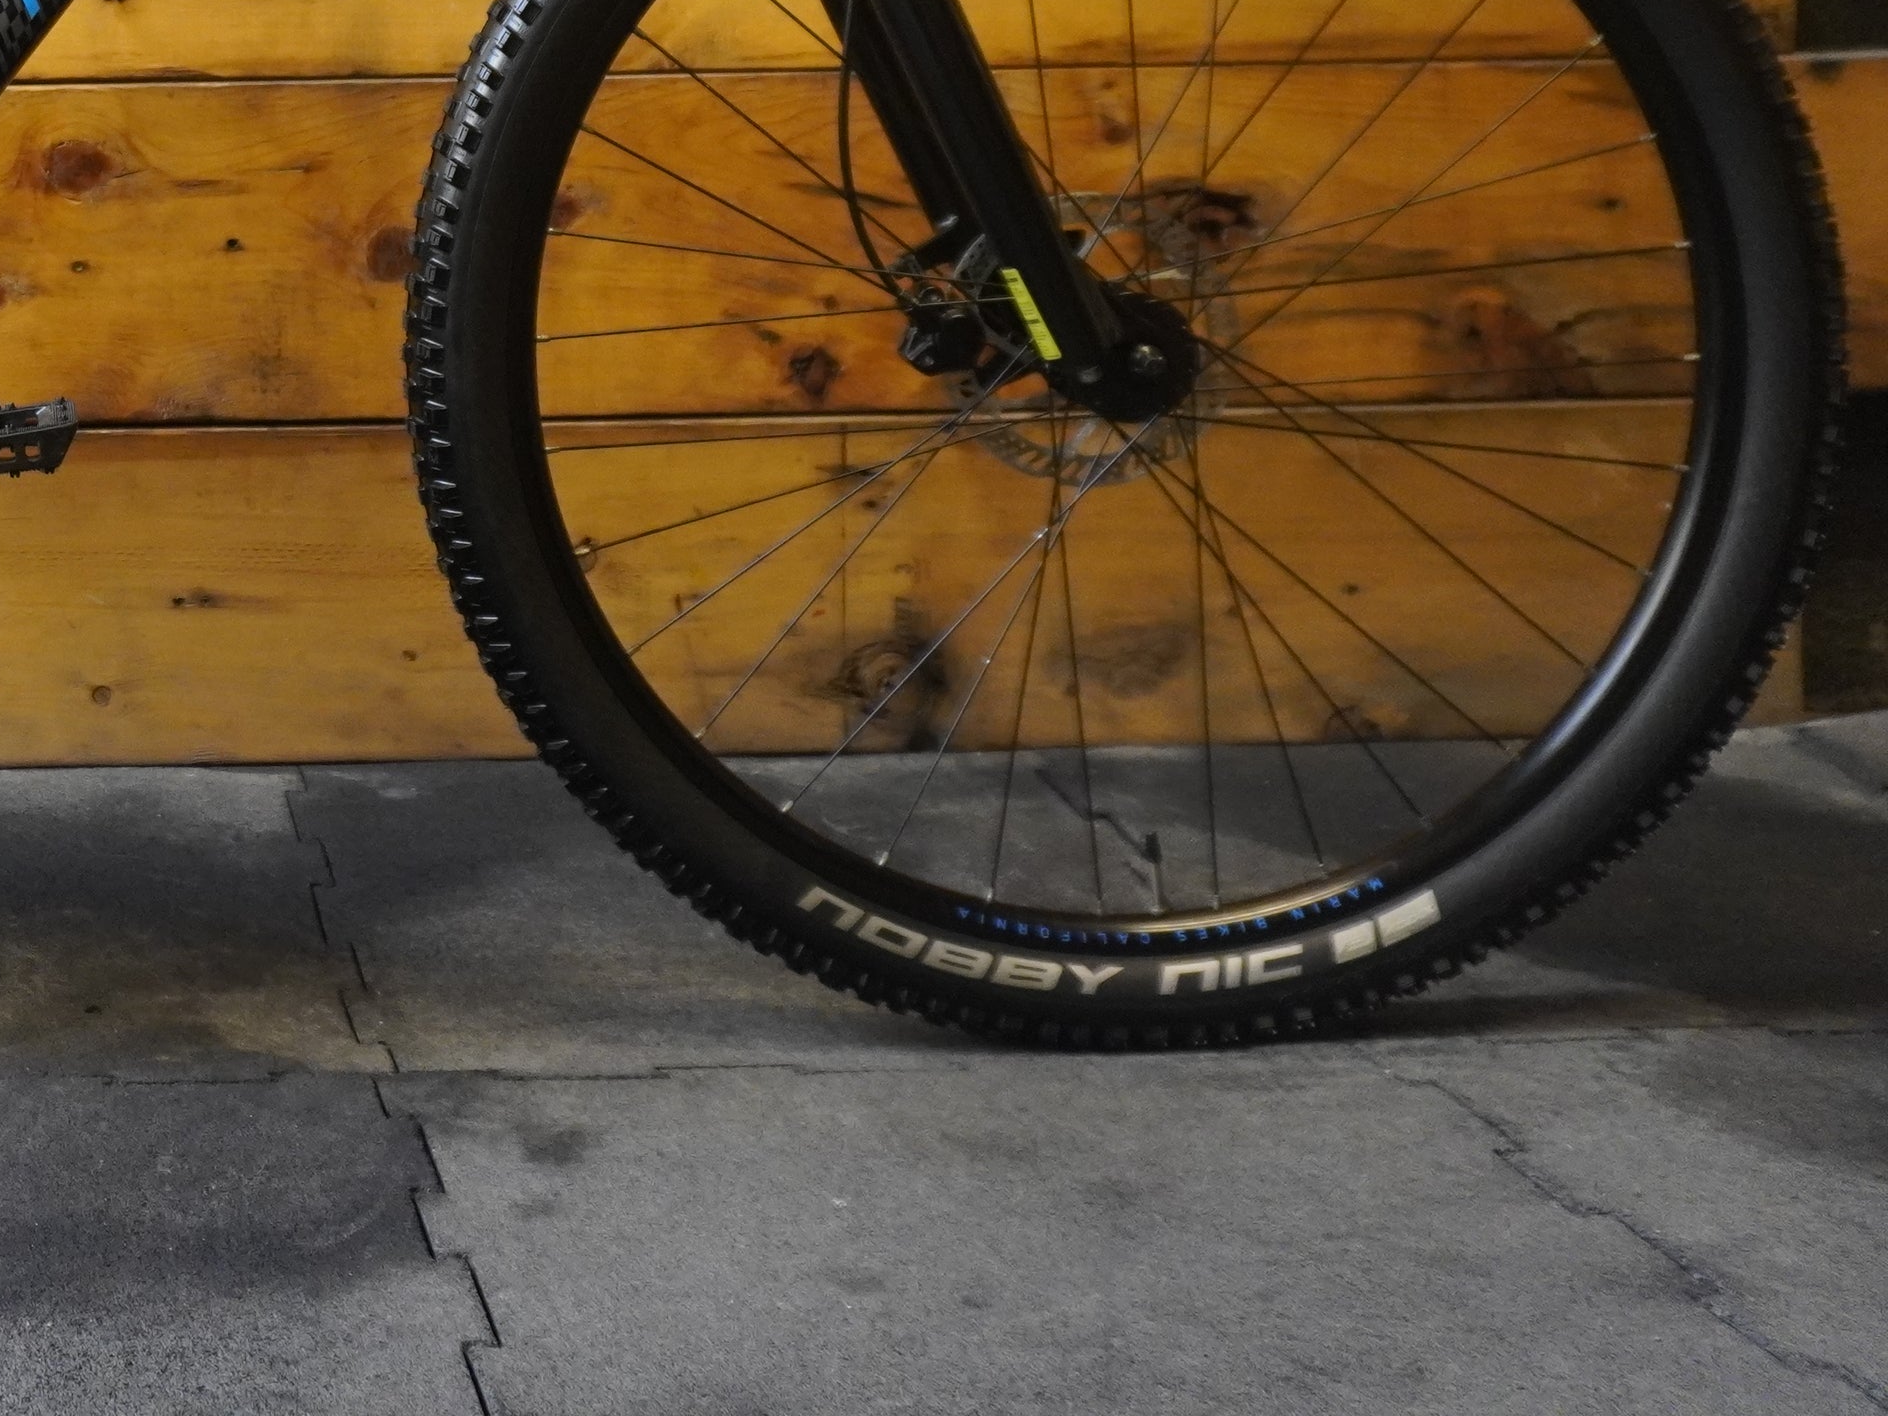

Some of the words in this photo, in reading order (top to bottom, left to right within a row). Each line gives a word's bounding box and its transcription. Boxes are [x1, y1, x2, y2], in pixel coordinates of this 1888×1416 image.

[1287, 875, 1384, 921] MARIN
[954, 906, 1151, 945] CALIFORNIA
[1174, 916, 1268, 943] BIKES
